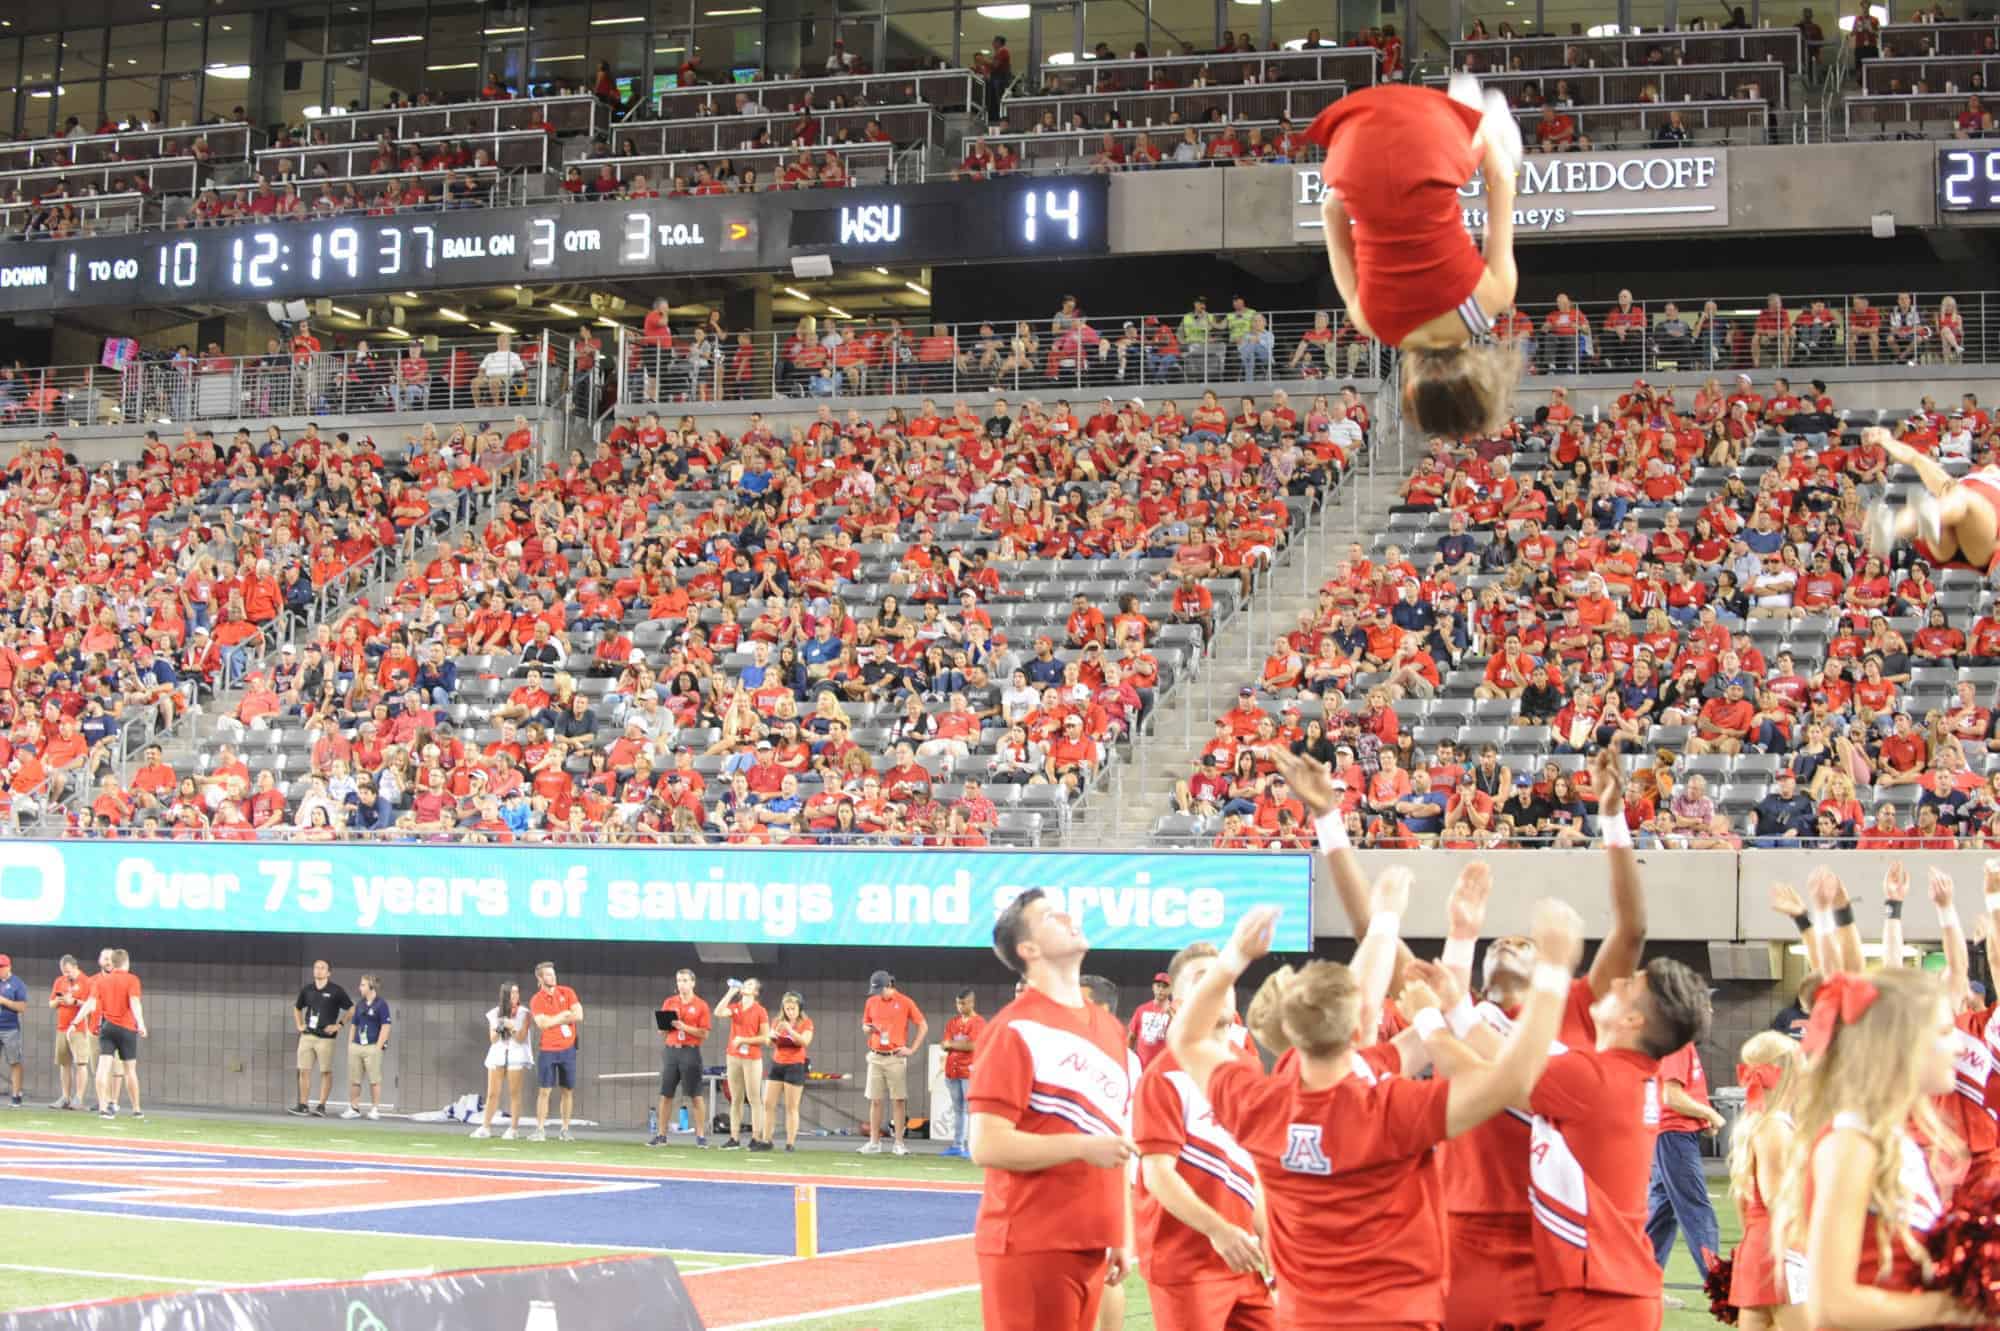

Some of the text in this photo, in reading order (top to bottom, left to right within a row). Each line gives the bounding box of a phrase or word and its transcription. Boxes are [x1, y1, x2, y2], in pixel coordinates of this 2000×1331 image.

[1521, 157, 1716, 194] MEDCOFF
[619, 212, 652, 261] 3
[840, 204, 901, 244] WSU
[1024, 189, 1080, 242] 14
[159, 241, 198, 287] 10
[231, 227, 360, 288] 12:19
[378, 226, 515, 275] 37 BALL ON
[528, 218, 600, 266] 3 QTR
[0, 265, 48, 288] DOWN
[88, 260, 111, 281] TO
[113, 258, 138, 280] GO
[116, 857, 240, 911] Over
[258, 860, 333, 913] 75
[353, 874, 509, 929] years
[529, 865, 588, 919] of
[607, 867, 833, 937] savings
[856, 869, 971, 924] and
[1280, 1123, 1332, 1176] A
